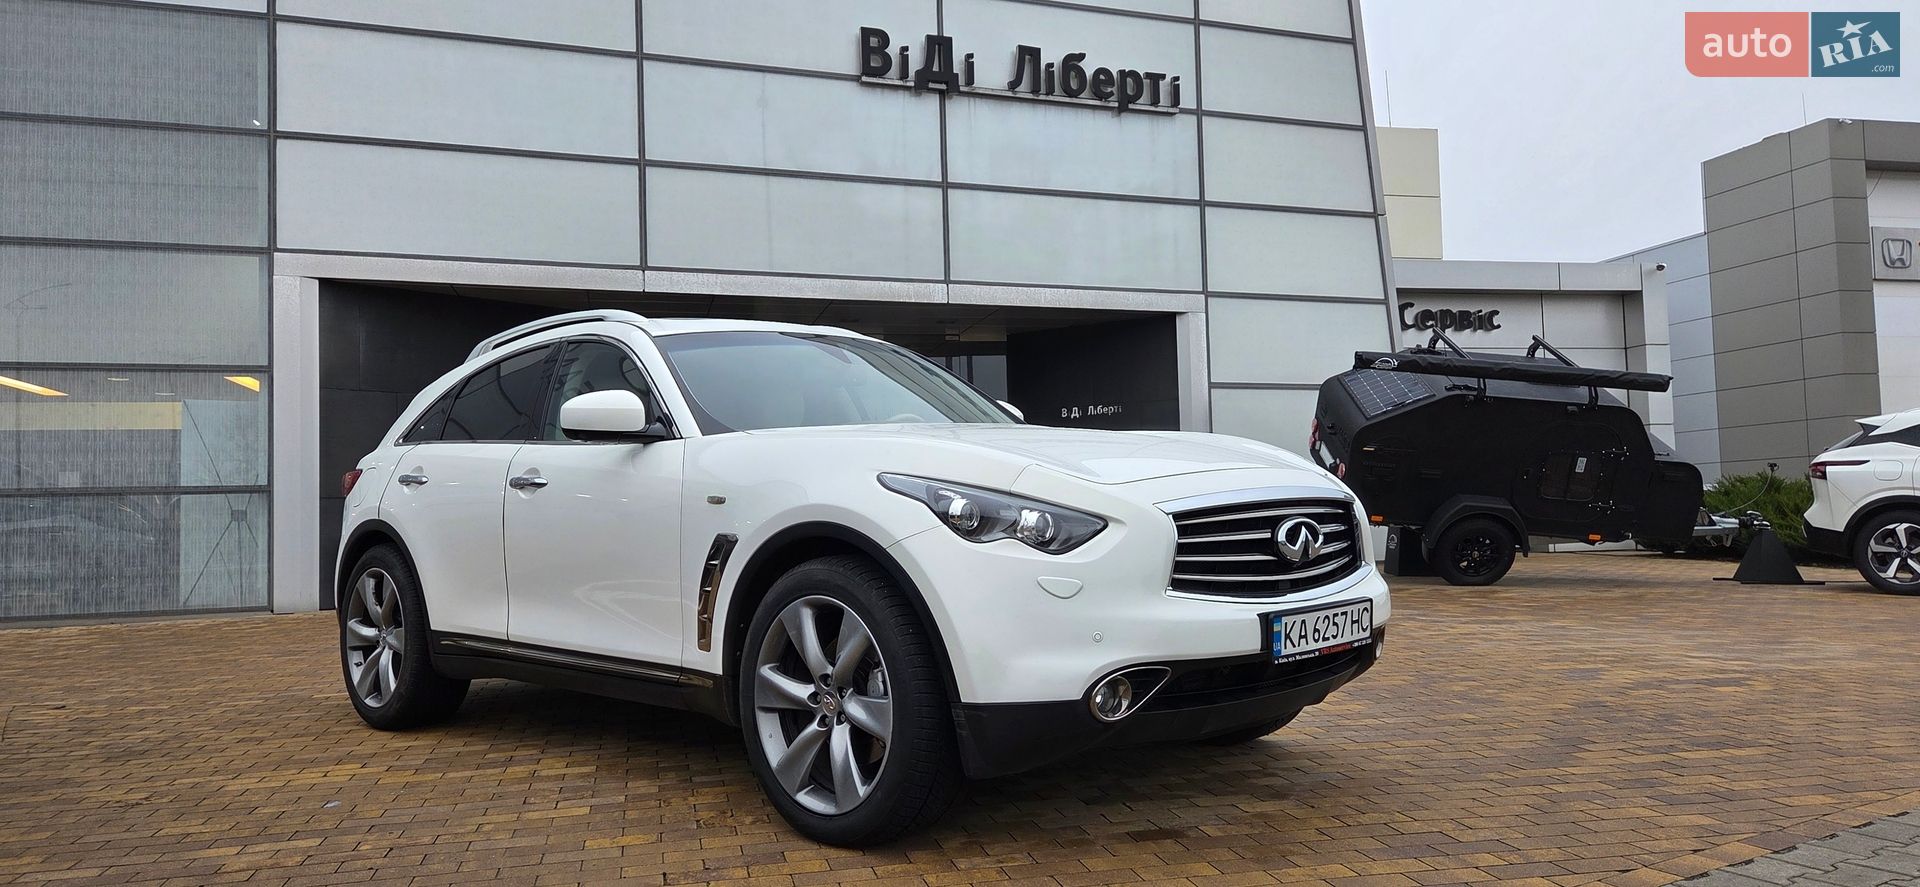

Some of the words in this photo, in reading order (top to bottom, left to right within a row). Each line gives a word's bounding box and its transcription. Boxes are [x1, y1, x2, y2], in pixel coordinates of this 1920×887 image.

[859, 26, 975, 93] ВіДі
[1007, 44, 1181, 113] Ліберті
[1398, 301, 1502, 333] Сервіс
[1088, 405, 1122, 416] Ліберті
[1284, 618, 1309, 650] KA
[1312, 611, 1348, 643] 6257
[1351, 607, 1369, 636] HC
